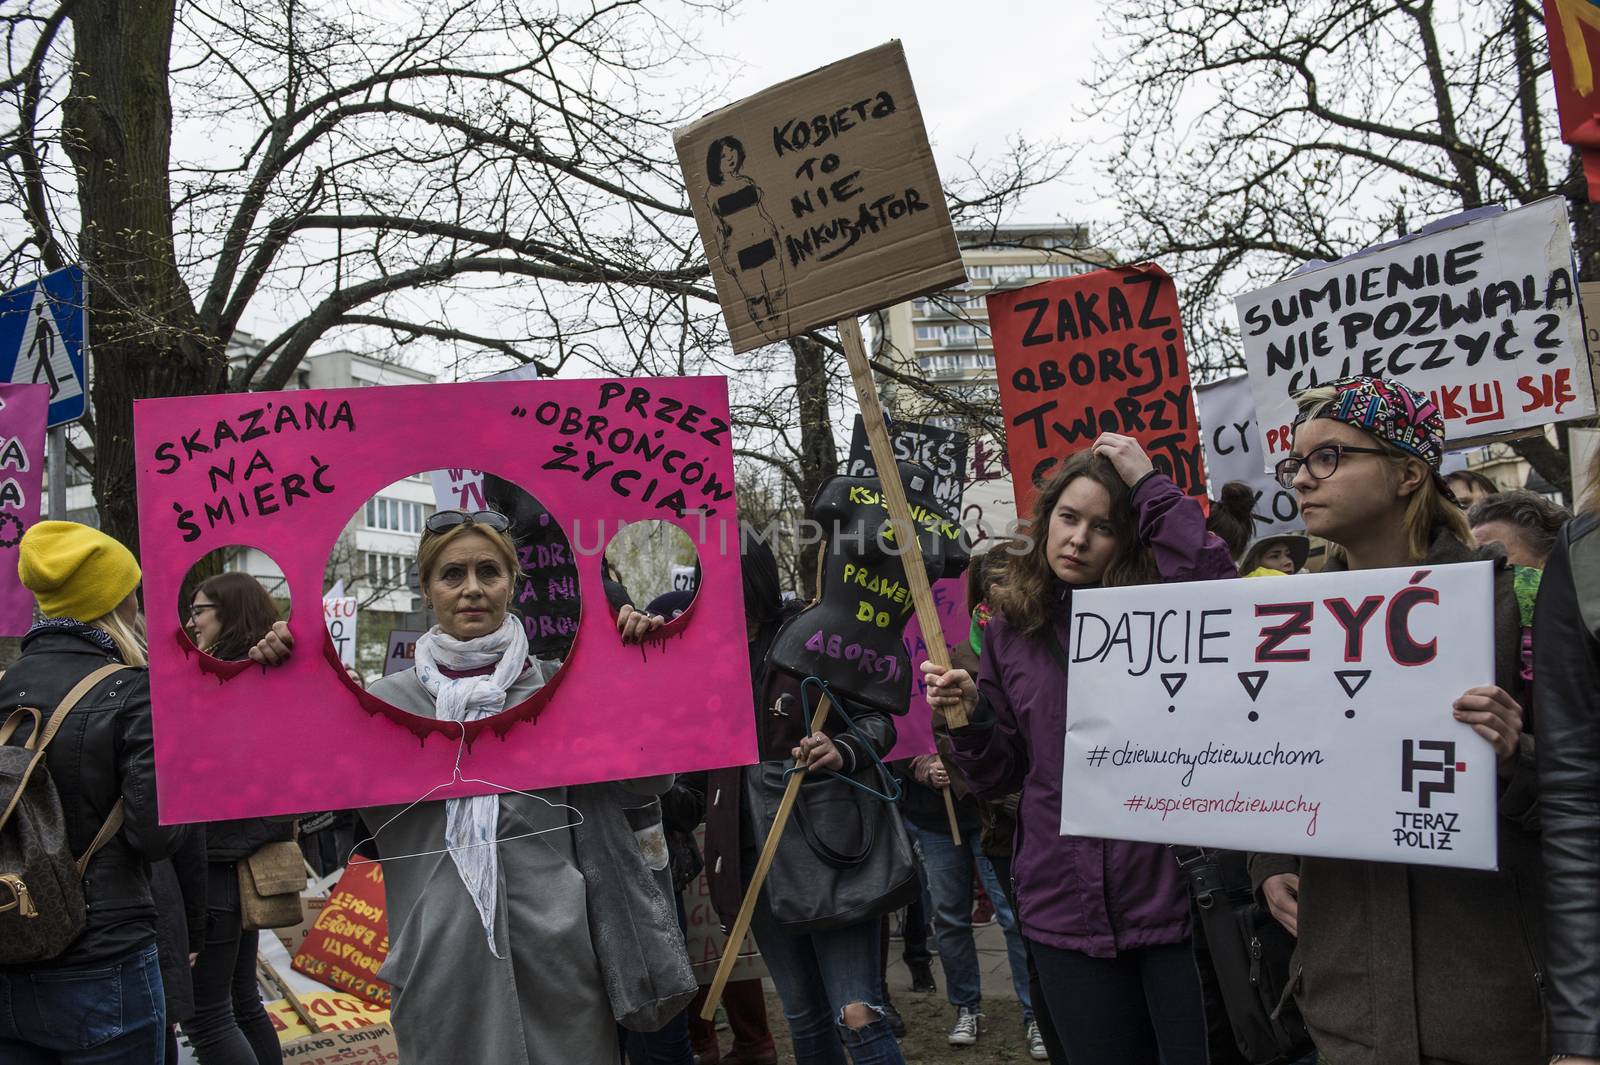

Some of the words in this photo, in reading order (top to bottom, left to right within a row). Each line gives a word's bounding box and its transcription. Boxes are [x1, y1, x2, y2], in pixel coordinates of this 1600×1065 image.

[796, 153, 840, 181] TO
[791, 171, 863, 218] NIE
[1013, 273, 1172, 346] ZAKAZ
[1244, 240, 1485, 336] SUMIENIE
[1266, 322, 1334, 376] NIE
[1339, 267, 1574, 350] POZWALA
[598, 382, 728, 446] PRZEZ
[1516, 368, 1577, 415] SIĘ
[1013, 384, 1191, 448] TWORZY
[209, 449, 273, 493] NA
[856, 600, 890, 628] DO
[1072, 608, 1232, 676] DAJCIE
[1254, 570, 1440, 667] ŻYĆ
[1124, 791, 1321, 836] #wspieramdziewuchy
[1395, 811, 1460, 832] TERAZ
